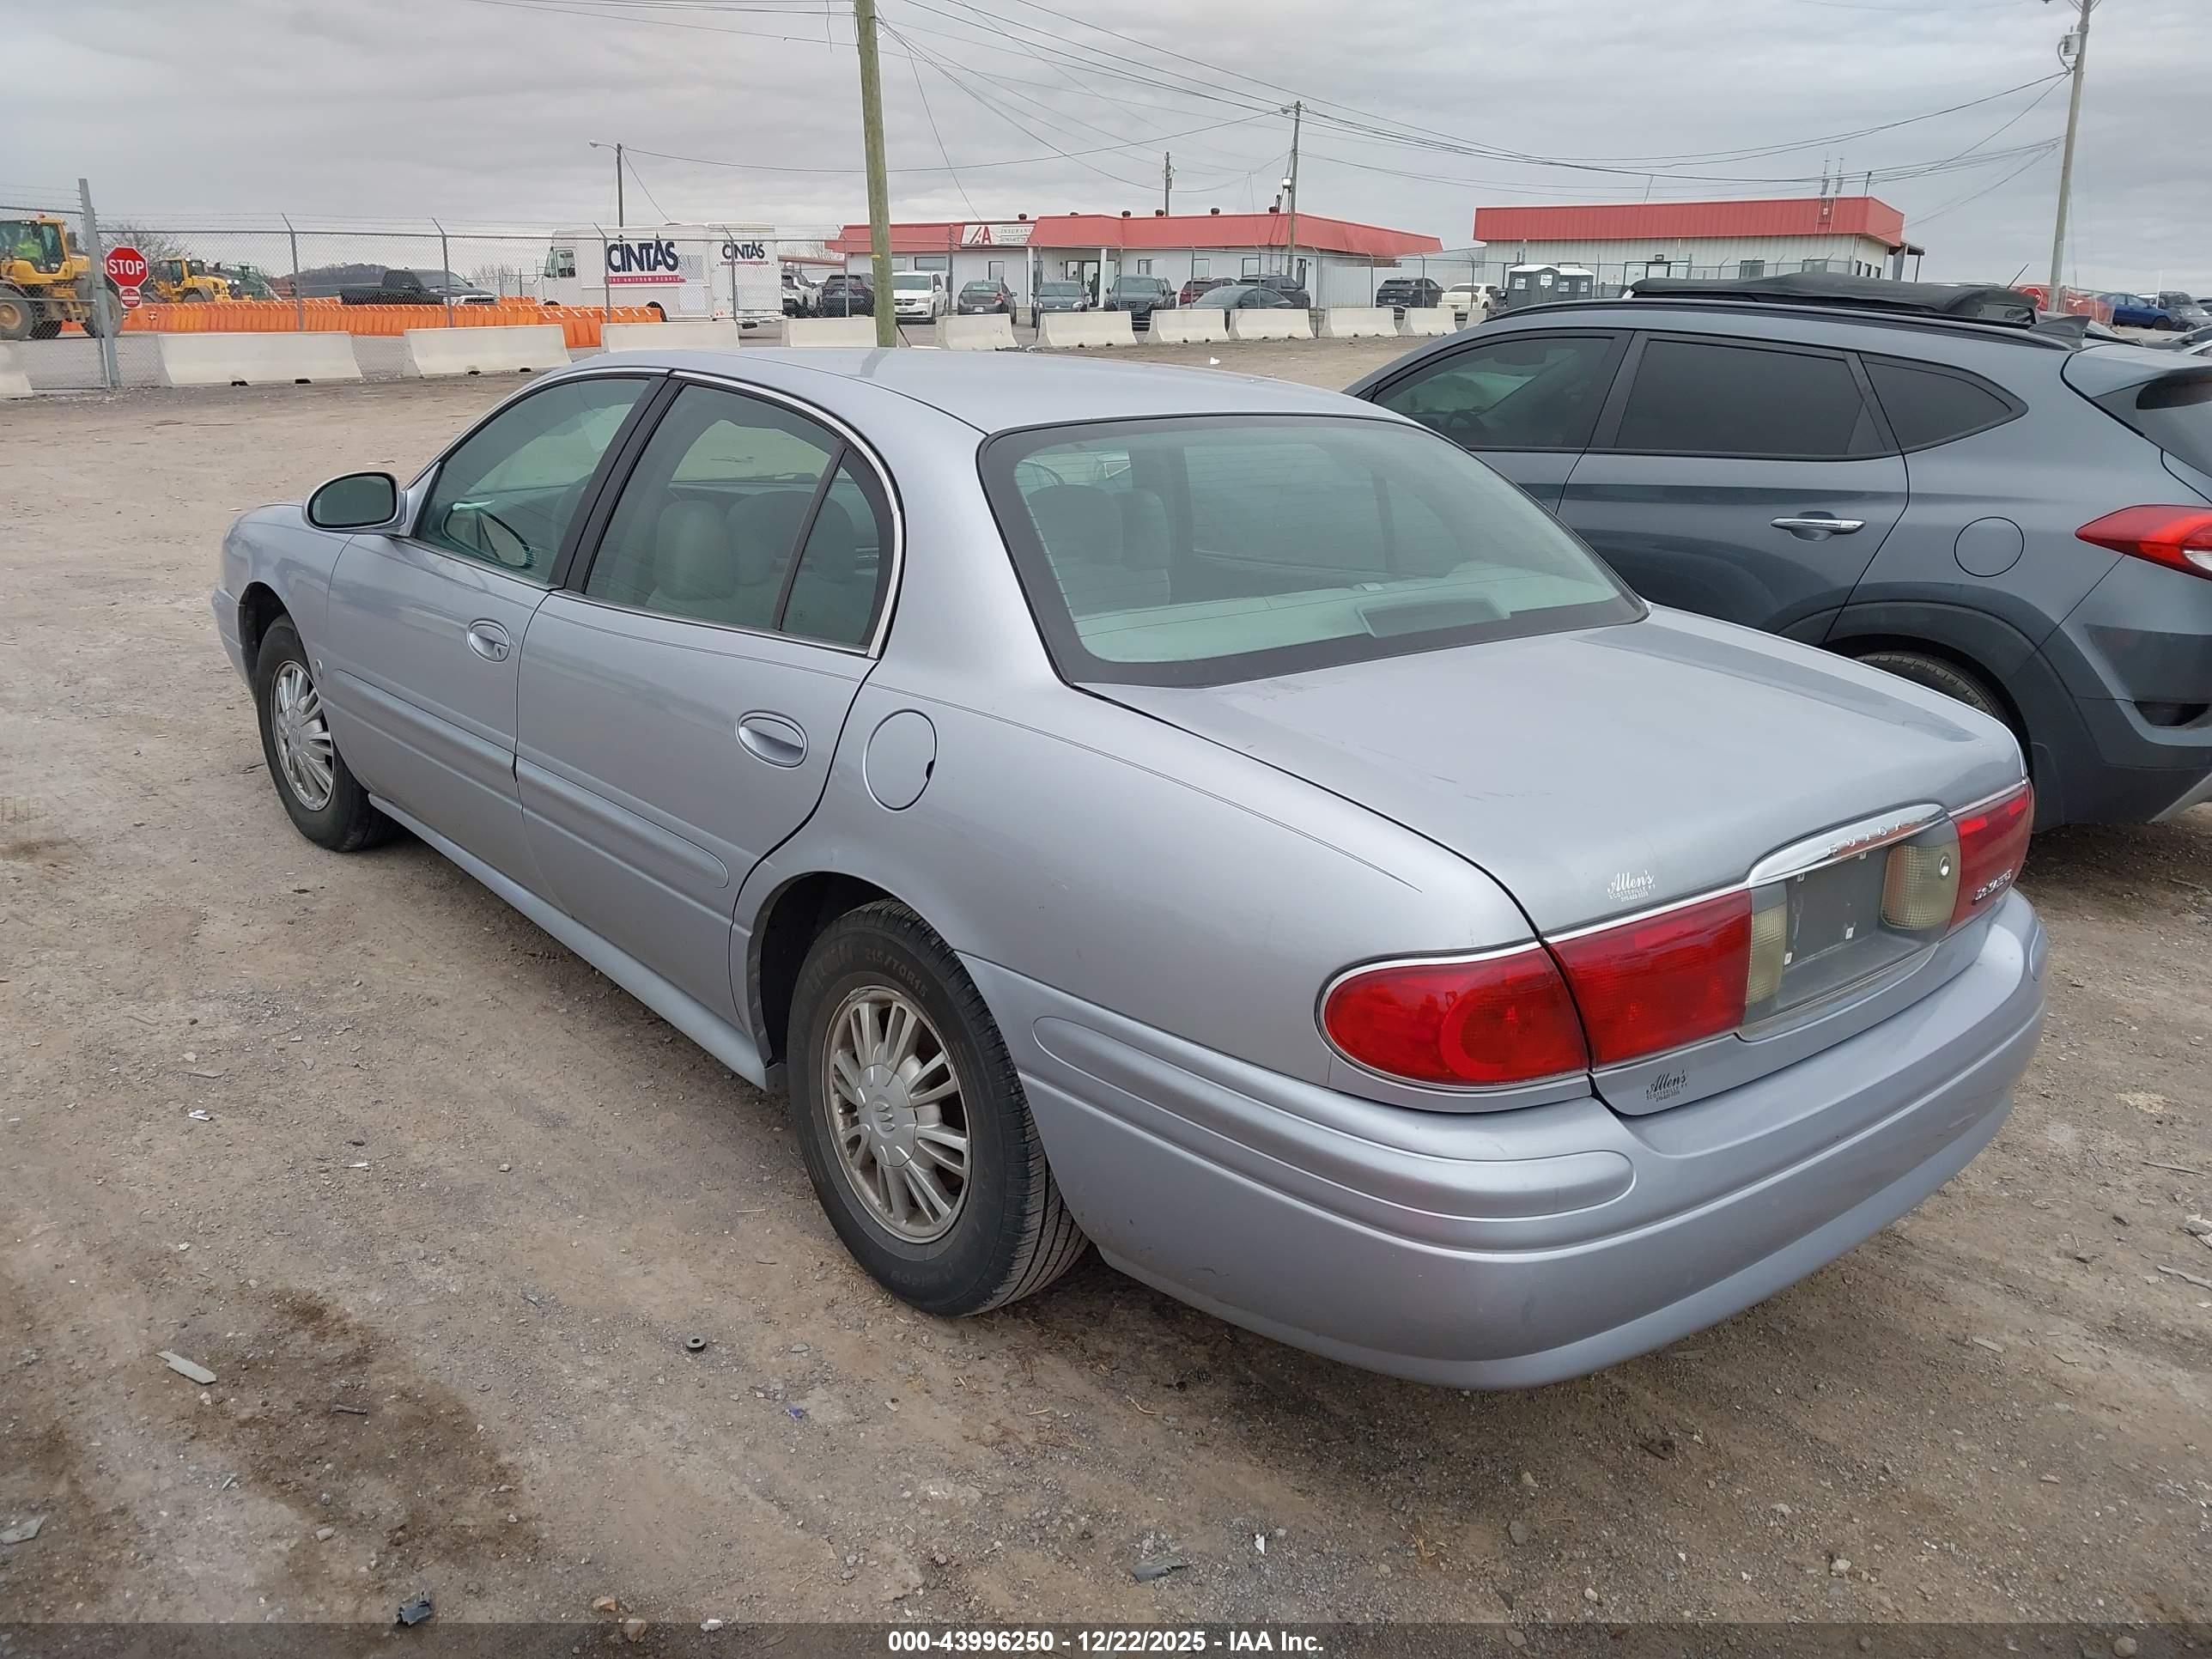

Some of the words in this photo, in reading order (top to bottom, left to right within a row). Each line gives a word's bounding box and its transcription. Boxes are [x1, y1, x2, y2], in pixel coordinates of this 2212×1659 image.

[607, 232, 679, 273] CINTAS
[722, 240, 765, 259] CNTAS
[108, 259, 145, 276] STOP
[1607, 869, 1656, 894] Allen's
[1646, 1069, 1686, 1095] Allen's
